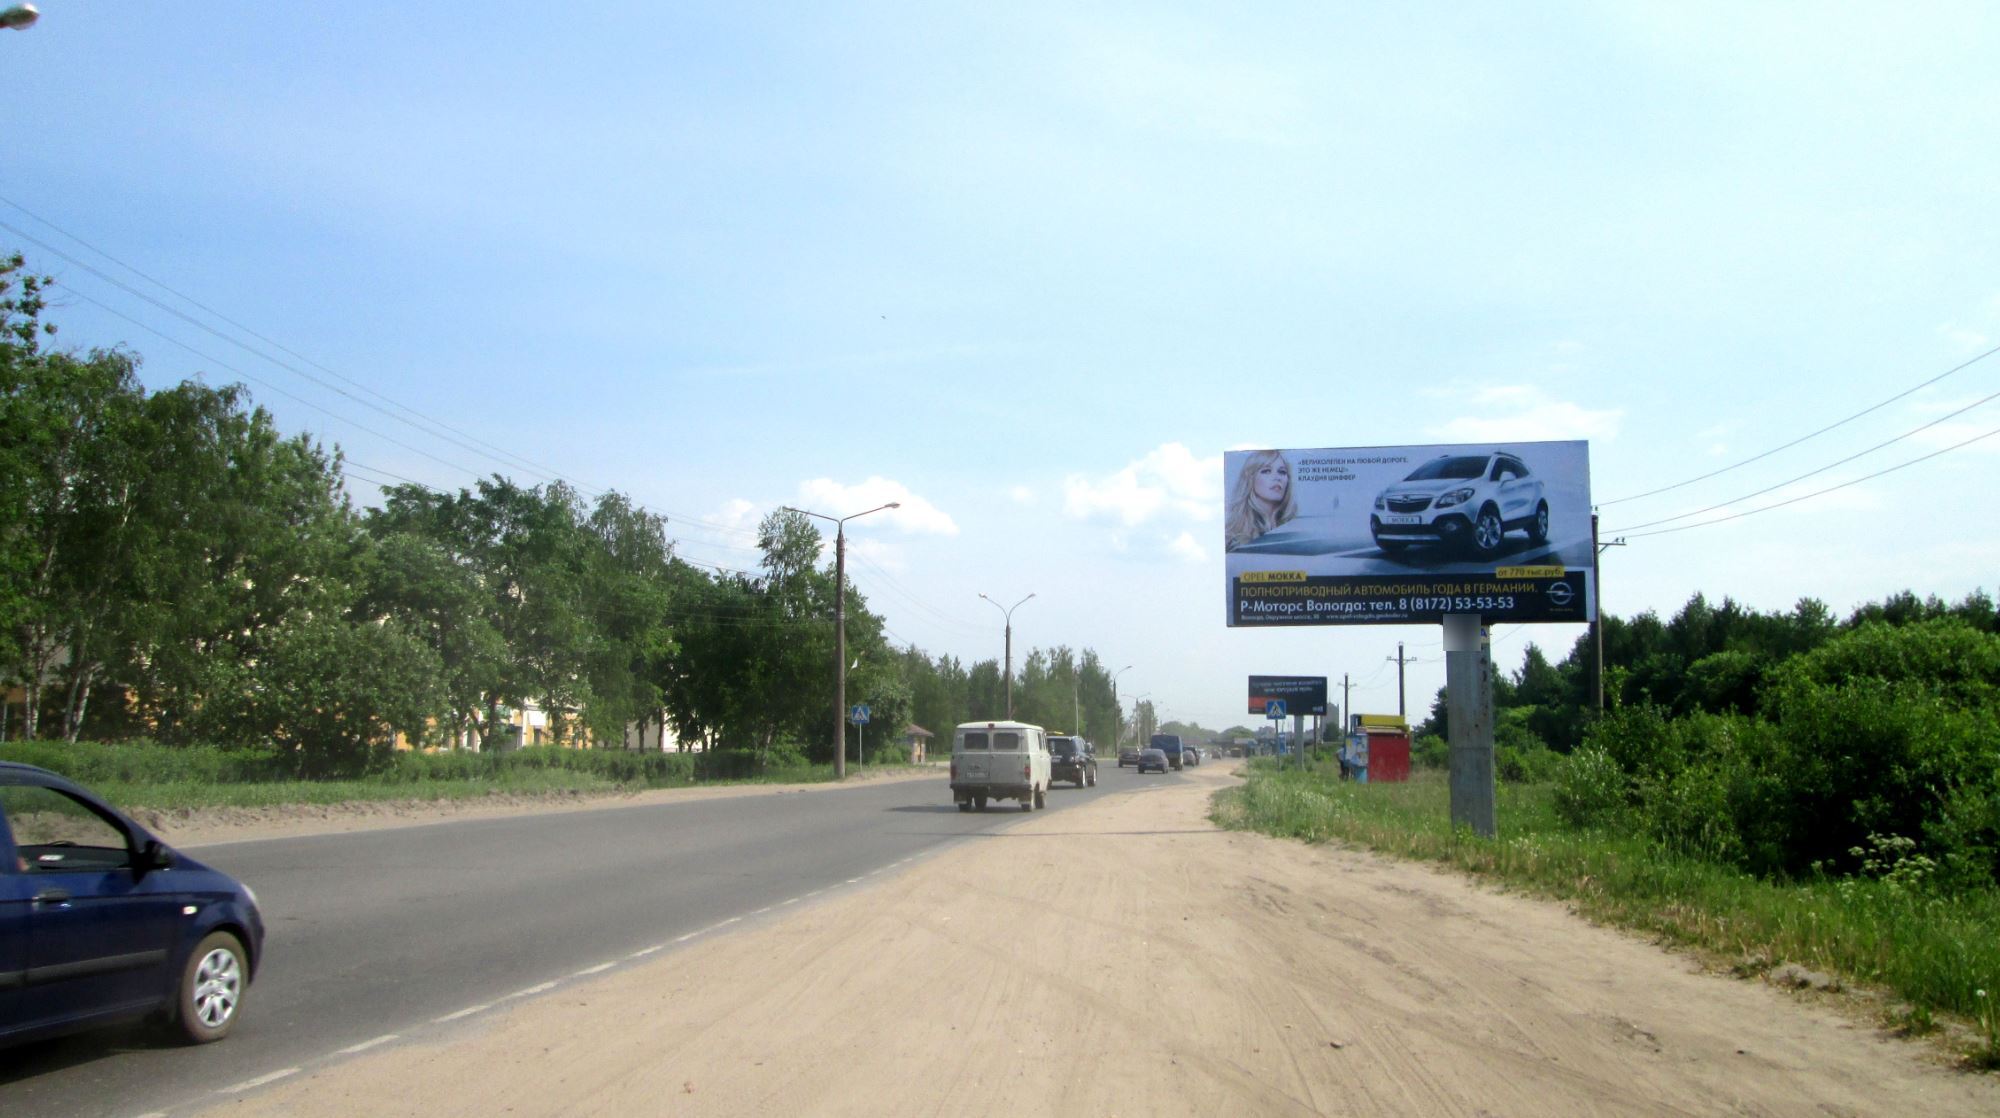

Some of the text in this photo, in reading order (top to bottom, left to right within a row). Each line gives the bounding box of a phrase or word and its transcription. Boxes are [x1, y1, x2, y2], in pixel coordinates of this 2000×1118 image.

[1243, 571, 1303, 581] OPEL MOKKA
[1497, 569, 1506, 577] от
[1510, 567, 1525, 577] 770
[1241, 582, 1538, 598] ПОЛНОПРИВОДНЫЙ АВТОМОБИЛЬ ГОДА В ГЕРМАНИИ.
[1241, 596, 1514, 614] Р-Моторс Вологда: тел. 8 (8172) 53-53-53
